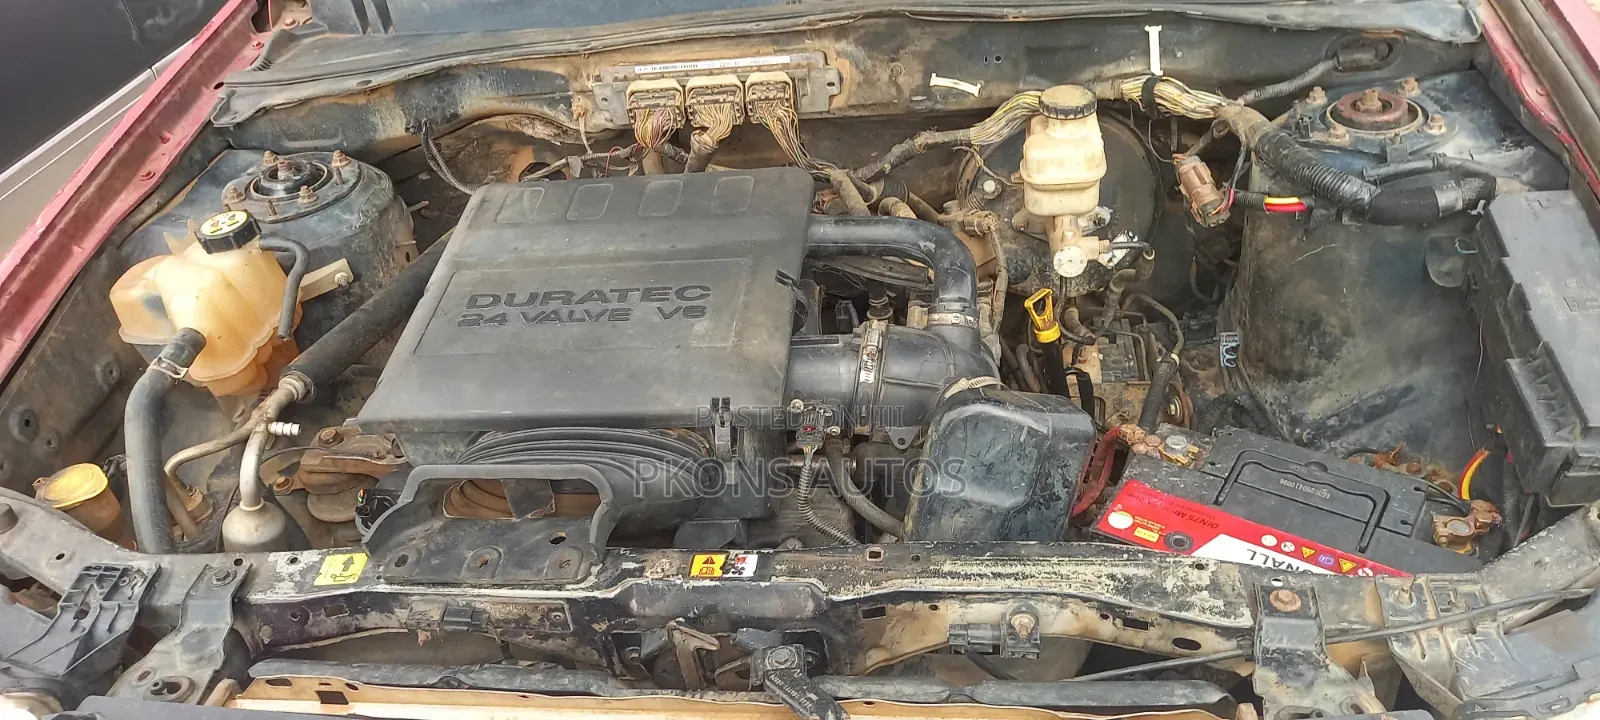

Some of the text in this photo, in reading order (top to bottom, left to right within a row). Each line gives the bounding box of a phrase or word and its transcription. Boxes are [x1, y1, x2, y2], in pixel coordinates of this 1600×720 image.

[465, 285, 712, 309] DURATEC
[457, 305, 707, 328] 24 VALVE V6
[1189, 513, 1219, 529] DIN75
